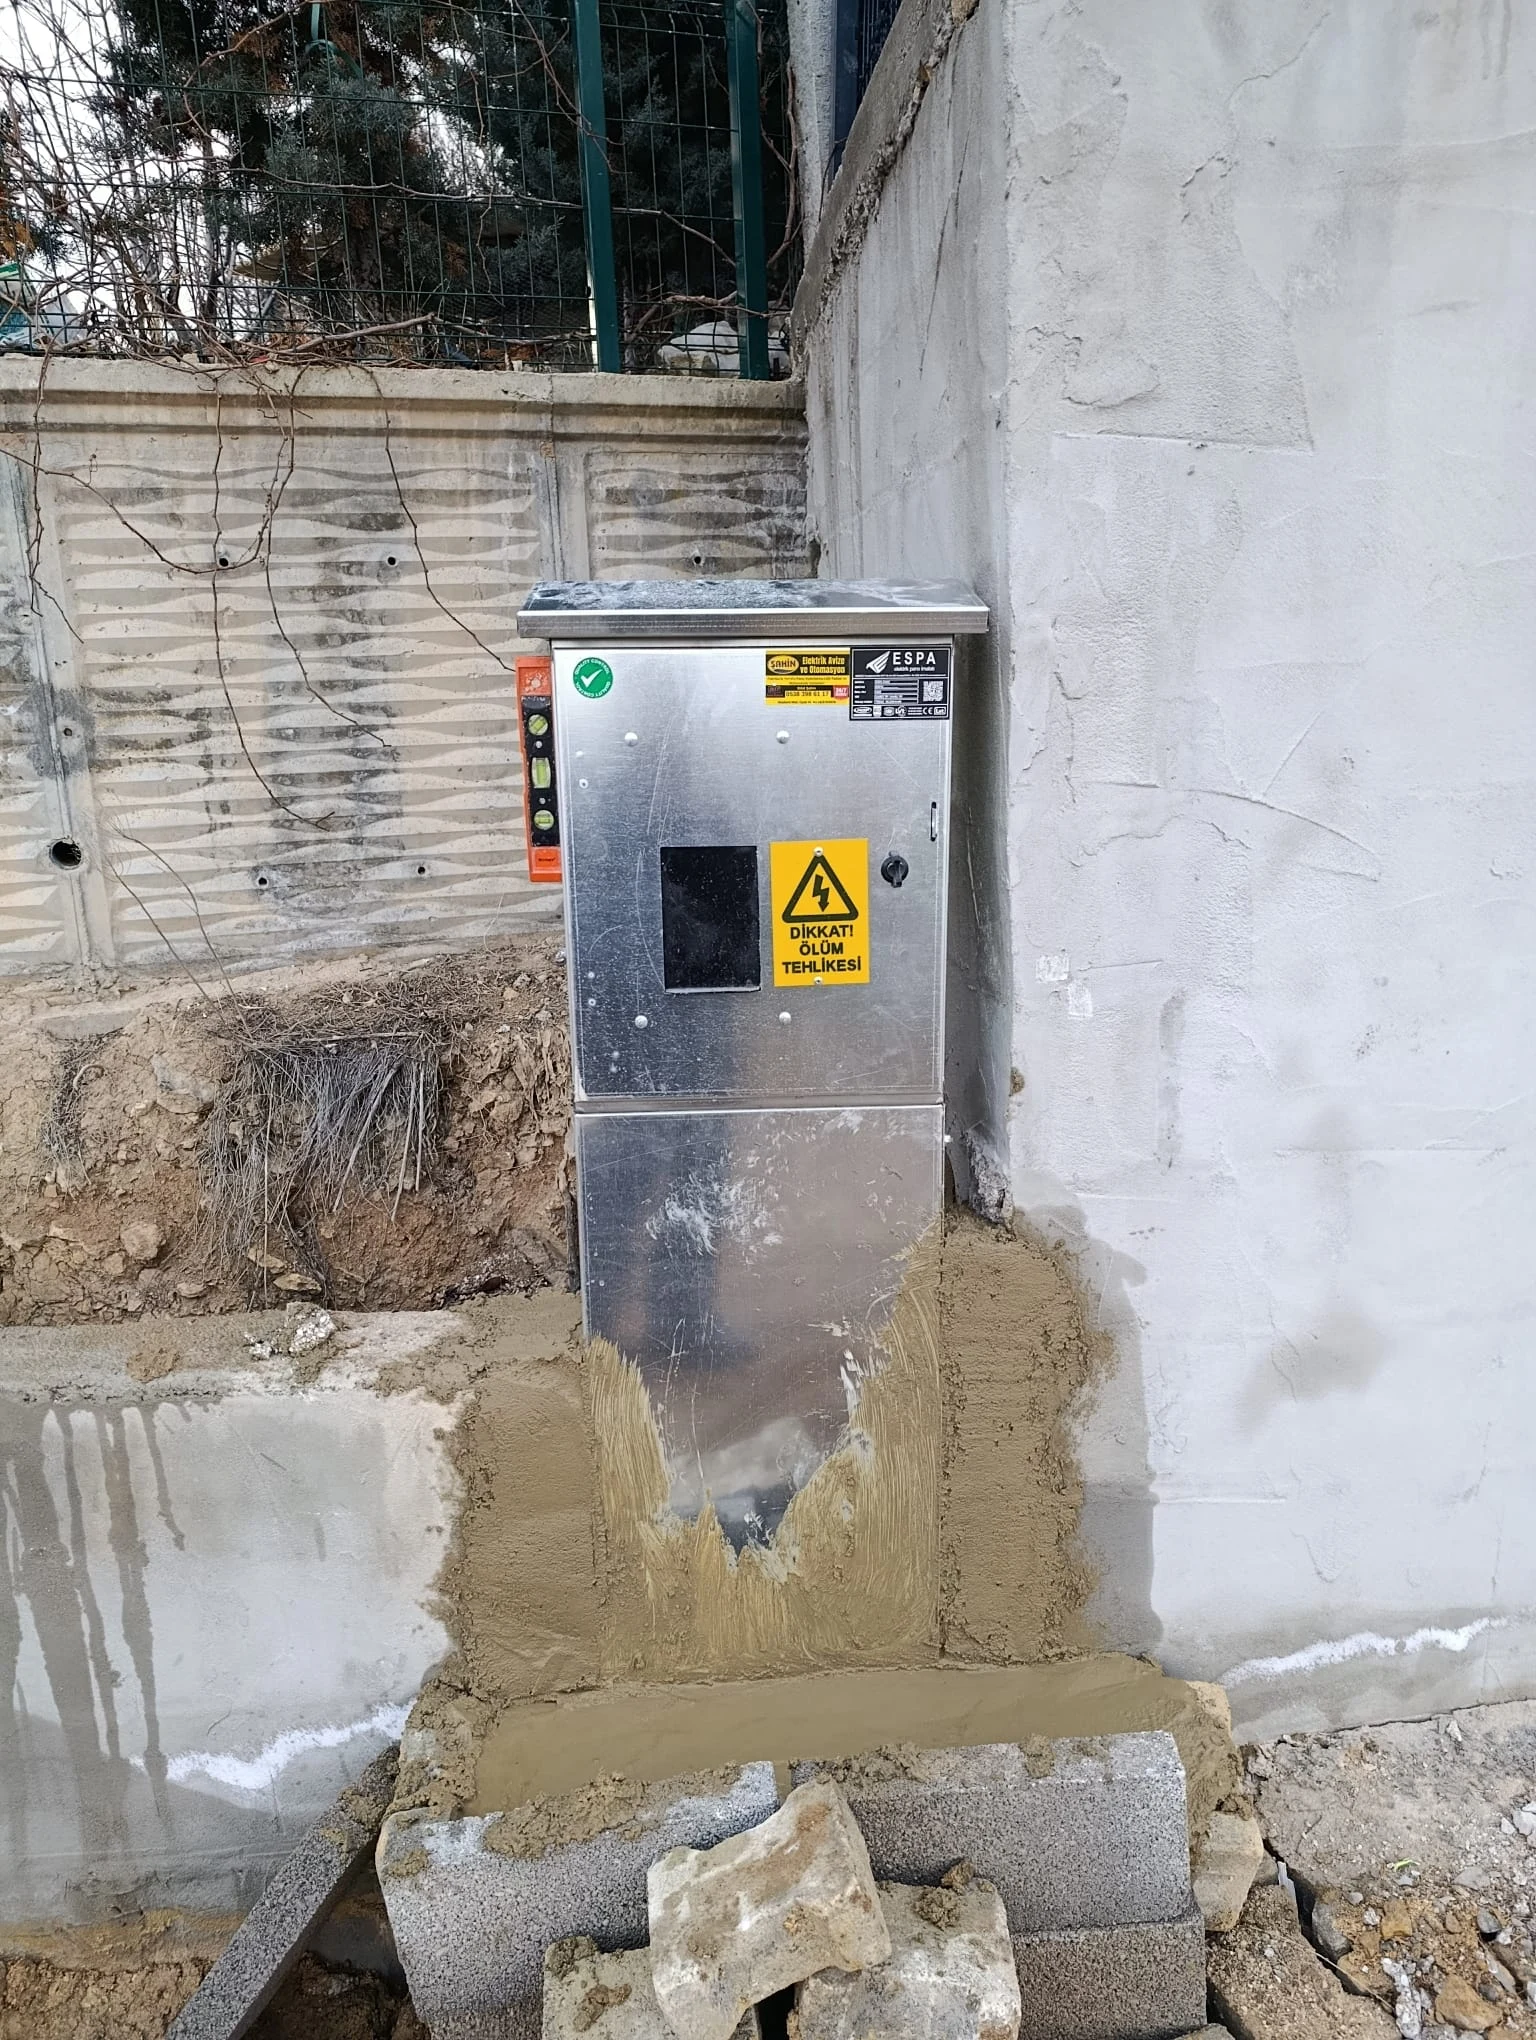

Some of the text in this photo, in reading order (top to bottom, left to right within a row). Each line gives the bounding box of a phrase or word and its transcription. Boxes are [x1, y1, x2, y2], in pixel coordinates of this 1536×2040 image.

[802, 656, 845, 665] Elektrik Avize
[893, 652, 936, 665] ESPA
[809, 665, 846, 675] Otomasyon
[790, 923, 853, 939] DİKKAT!
[799, 940, 844, 956] ÖLÜM
[782, 956, 861, 974] TEHLİKESİ
